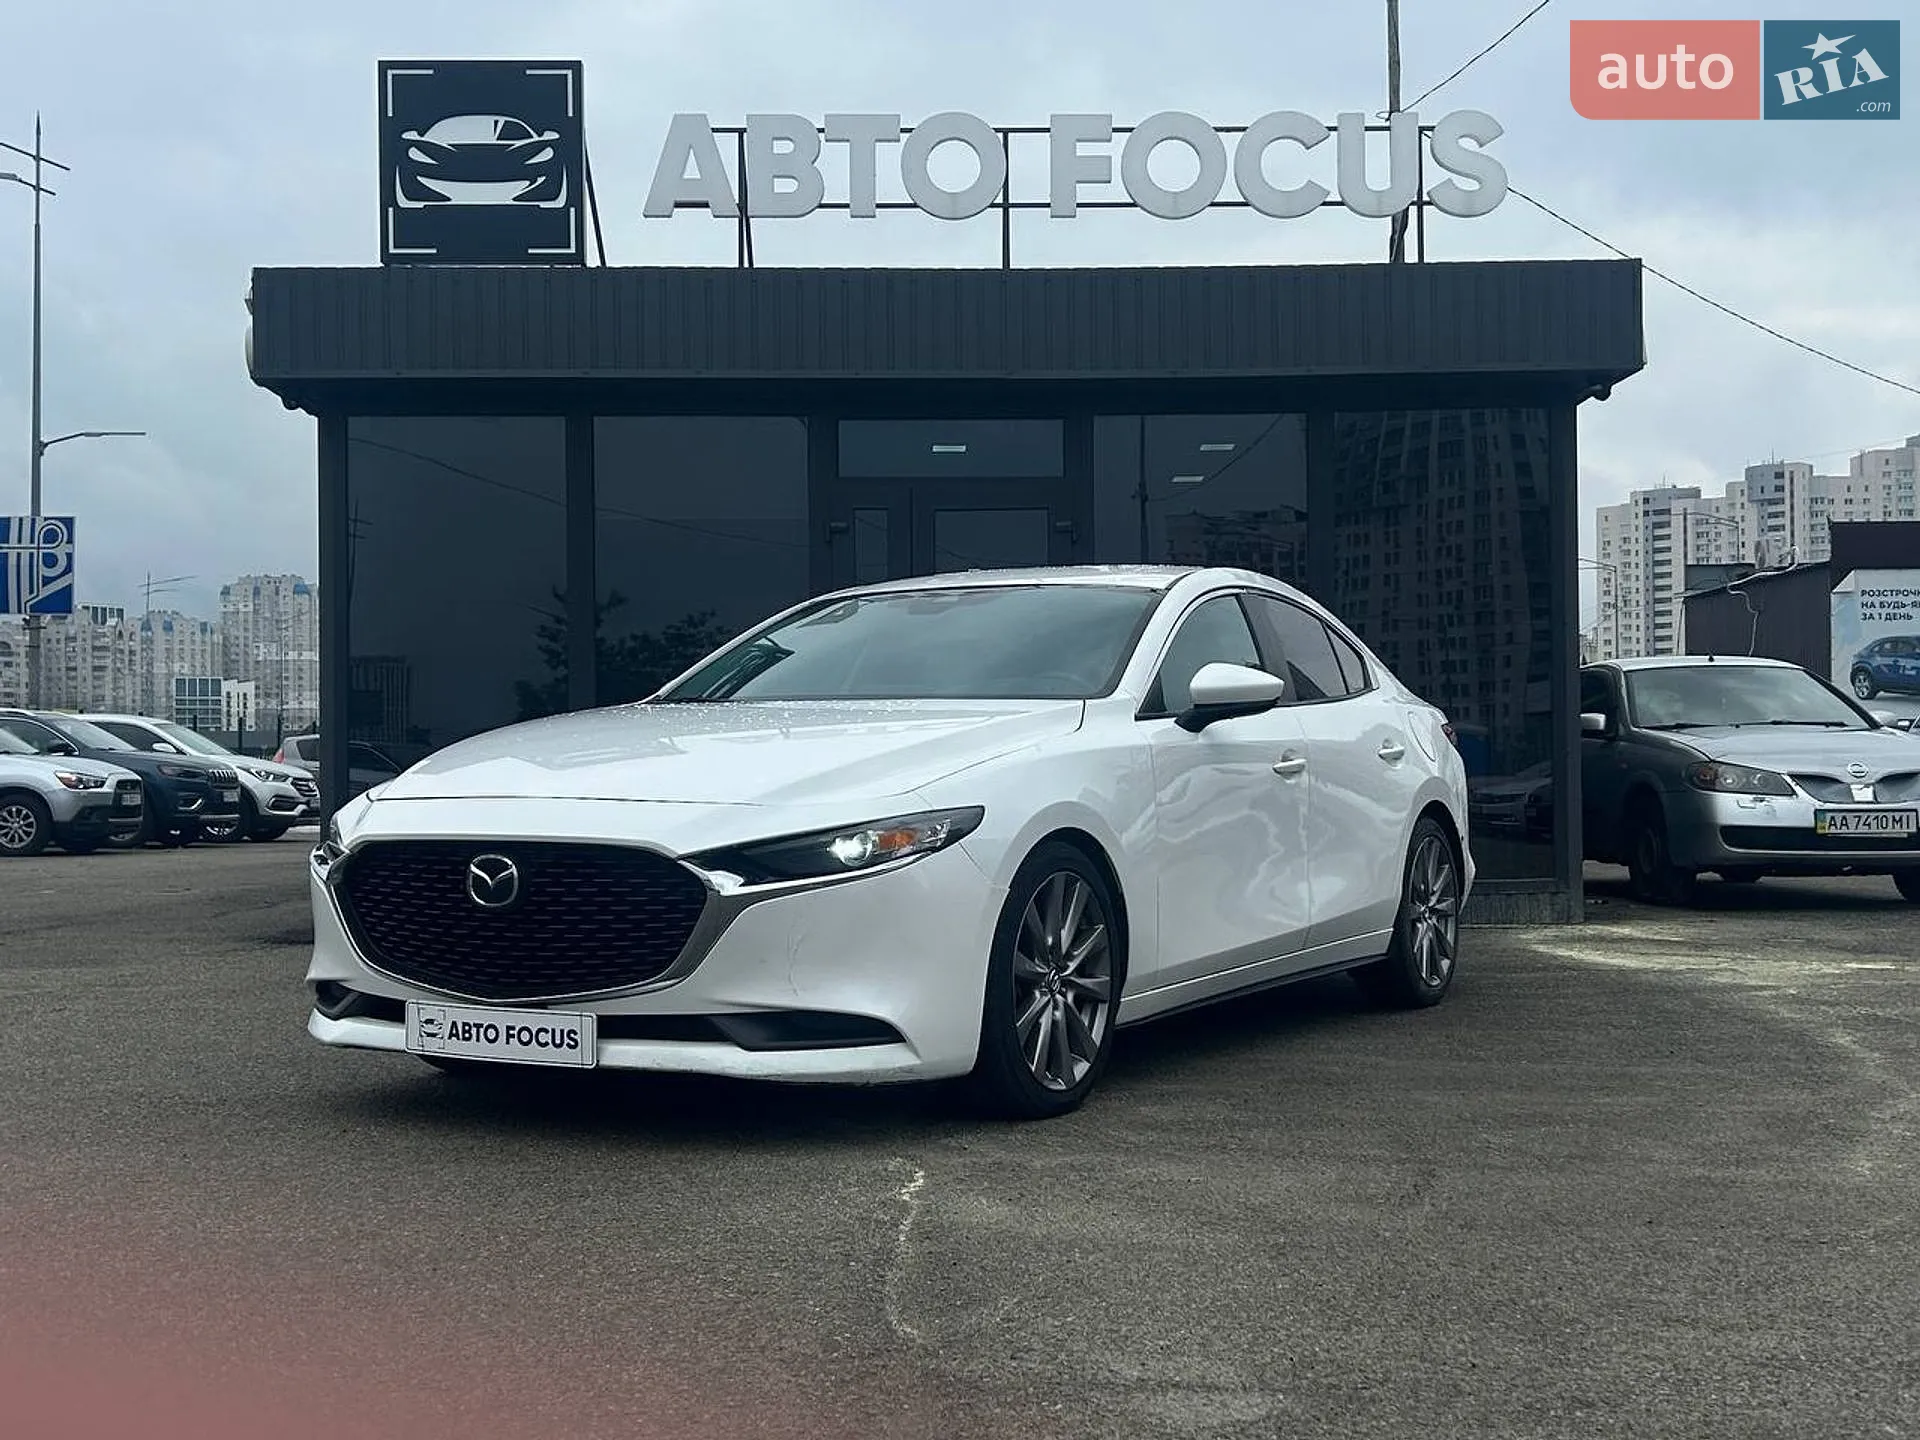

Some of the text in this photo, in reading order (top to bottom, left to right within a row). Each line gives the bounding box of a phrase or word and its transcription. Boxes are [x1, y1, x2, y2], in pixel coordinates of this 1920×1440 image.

[642, 109, 1508, 220] АВТО FOCUS
[1861, 600, 1920, 610] НА БУДЬ-Я
[1860, 612, 1875, 621] ЗА
[1884, 612, 1913, 622] ДЕНЬ
[447, 1020, 579, 1050] АВТО FOCUS
